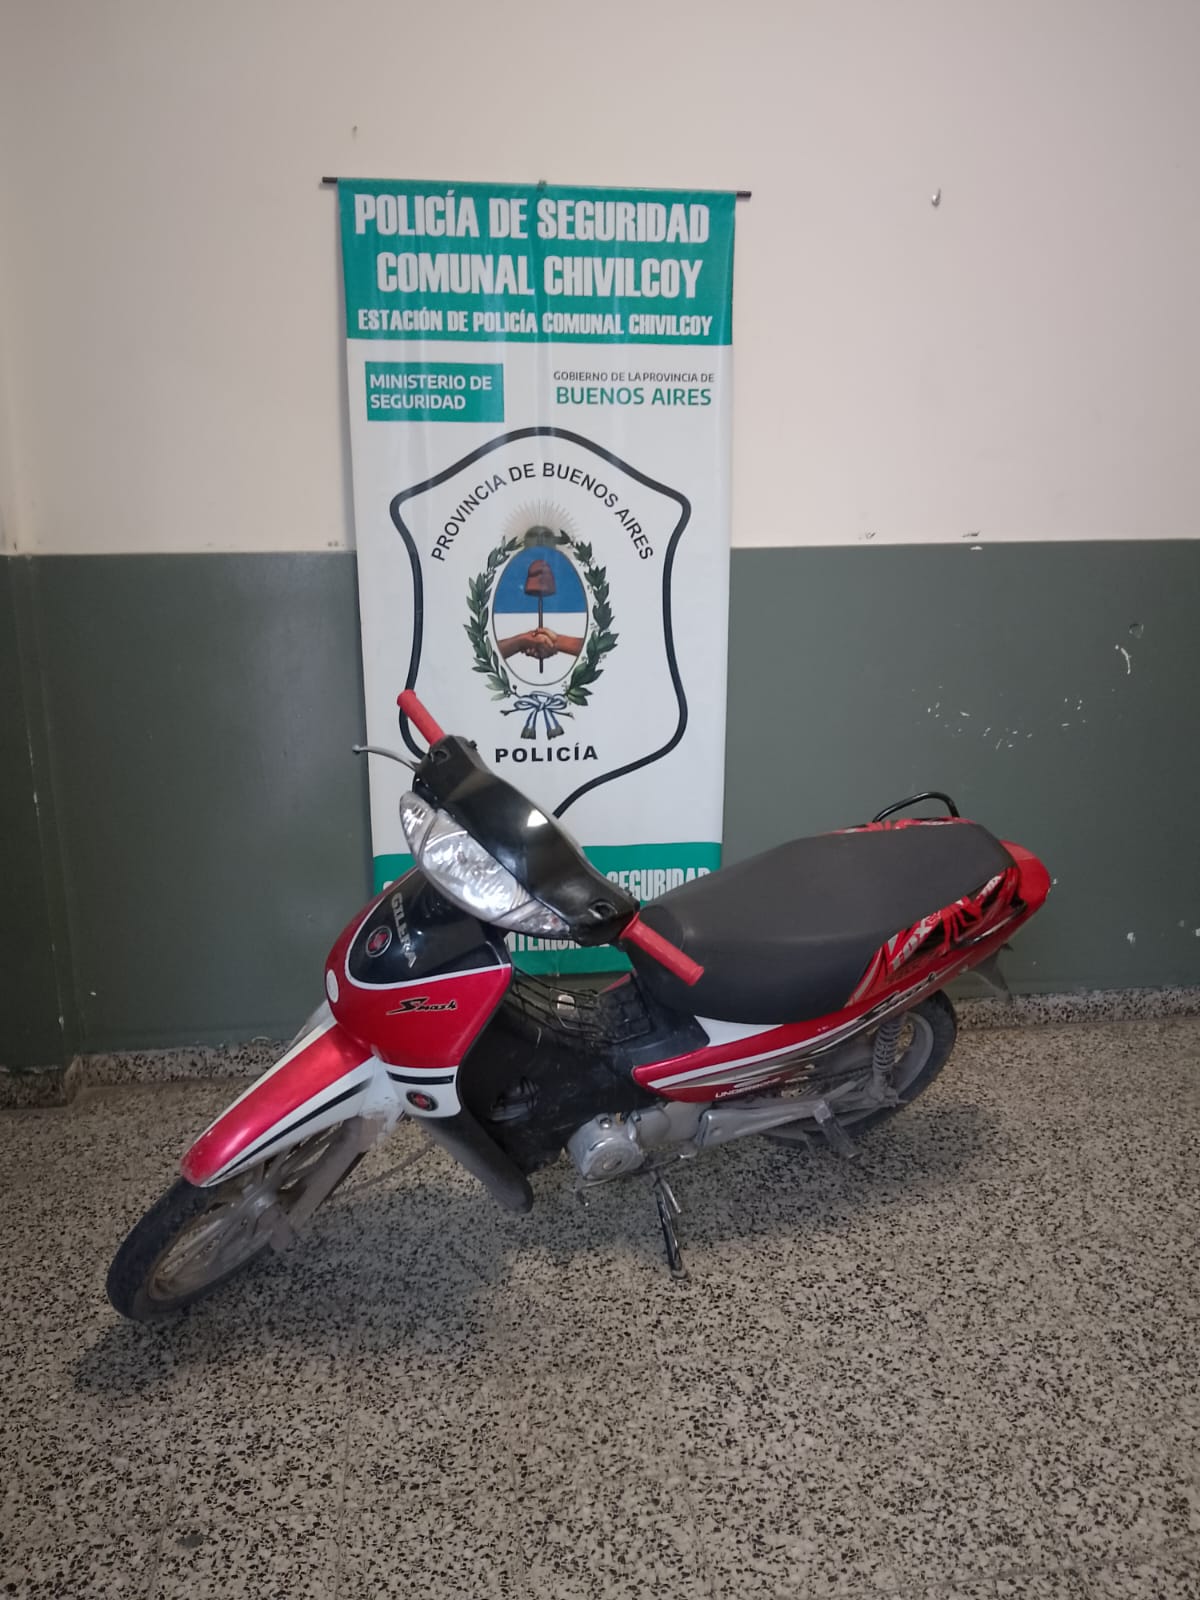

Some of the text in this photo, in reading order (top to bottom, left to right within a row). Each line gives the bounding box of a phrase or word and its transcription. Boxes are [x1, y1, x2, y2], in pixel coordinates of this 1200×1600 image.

[354, 190, 709, 244] POLICÍA DE SEGURIDAD
[376, 252, 703, 298] COMUNAL CHIVILCOY
[358, 307, 713, 336] ESTACIÓN DE POLICÍA COMUNAL CHIVILCOY
[369, 374, 493, 390] MINISTERIO DE
[553, 370, 715, 383] GOBIERNO DE LA PROVINCIA DE
[370, 394, 466, 410] SEGURIDAD
[556, 386, 712, 406] BUENOS AIRES
[431, 462, 654, 561] PROVINCIA DE BUENOS AIRES
[495, 743, 599, 763] POLICÍA
